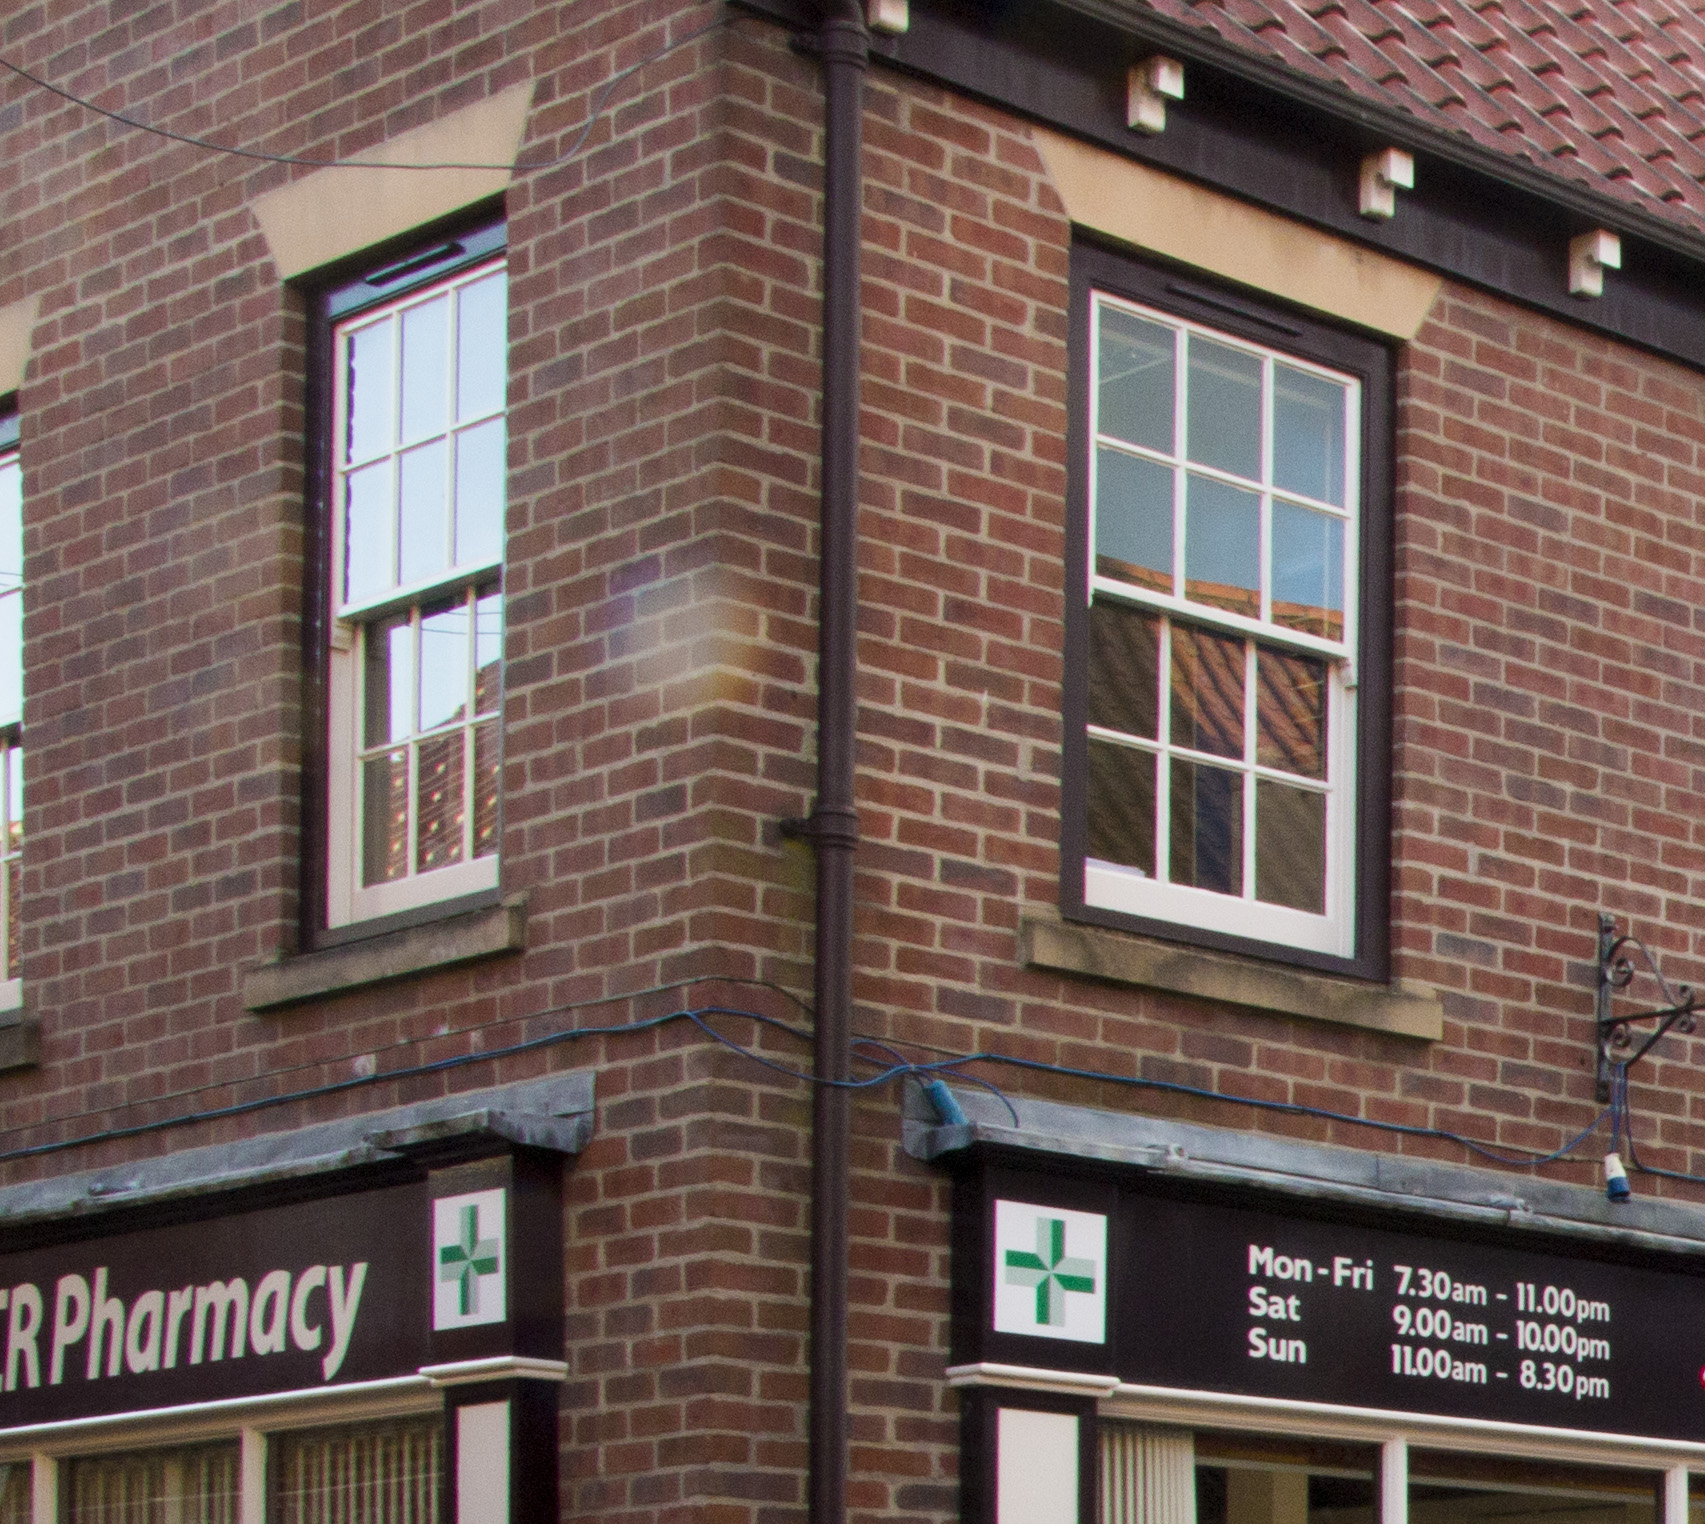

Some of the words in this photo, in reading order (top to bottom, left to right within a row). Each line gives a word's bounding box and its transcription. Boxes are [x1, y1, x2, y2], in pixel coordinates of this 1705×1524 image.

[0, 1282, 44, 1393] R
[48, 1261, 369, 1382] Pharmacy
[1249, 1286, 1301, 1323] Sat
[1393, 1305, 1488, 1346] 9.00am
[1516, 1320, 1610, 1361] 10.00pm
[1394, 1265, 1487, 1307] 7.30am
[1516, 1281, 1610, 1323] 11.00pm
[1249, 1326, 1307, 1365] Sun
[1391, 1343, 1487, 1385] 11.00am
[1520, 1359, 1610, 1400] 8.30pm
